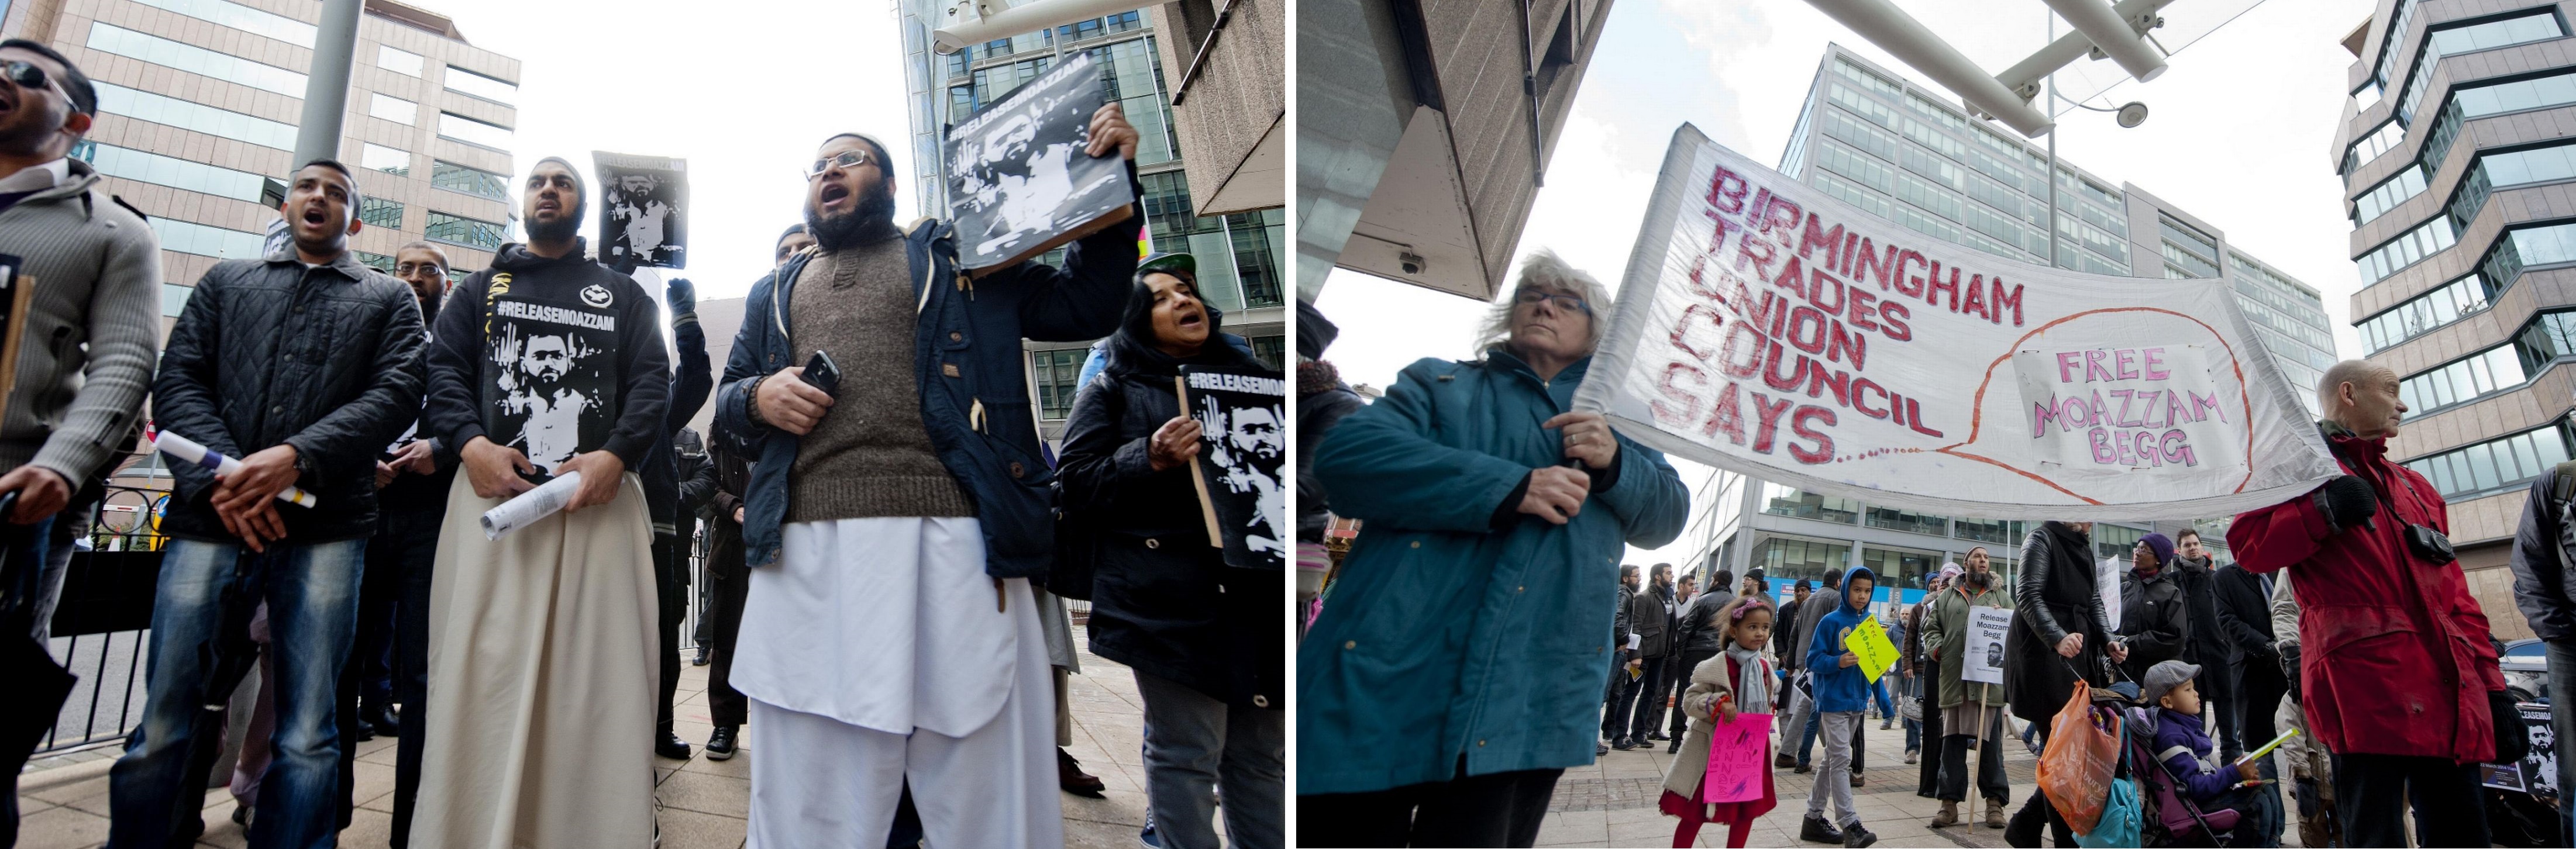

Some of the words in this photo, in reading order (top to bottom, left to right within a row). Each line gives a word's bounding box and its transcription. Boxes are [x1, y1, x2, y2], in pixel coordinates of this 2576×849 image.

[948, 52, 1089, 142] #RELEASEMOAZZAM
[596, 155, 684, 172] #RELEASEMOAZZAM
[1704, 164, 2025, 327] BIRMINGHAM
[1703, 209, 1912, 342] TRADES
[497, 301, 614, 332] #RELEASEMOAZZAM
[1690, 254, 1865, 371] UNION
[1669, 303, 1944, 439] COUNCIL
[2056, 348, 2171, 383] FREE
[2034, 388, 2227, 439] MOAZZAM
[2088, 427, 2198, 467] BEGG
[1976, 622, 2009, 631] Moazzam
[1981, 613, 2007, 622] Release
[1983, 630, 2001, 640] Begg
